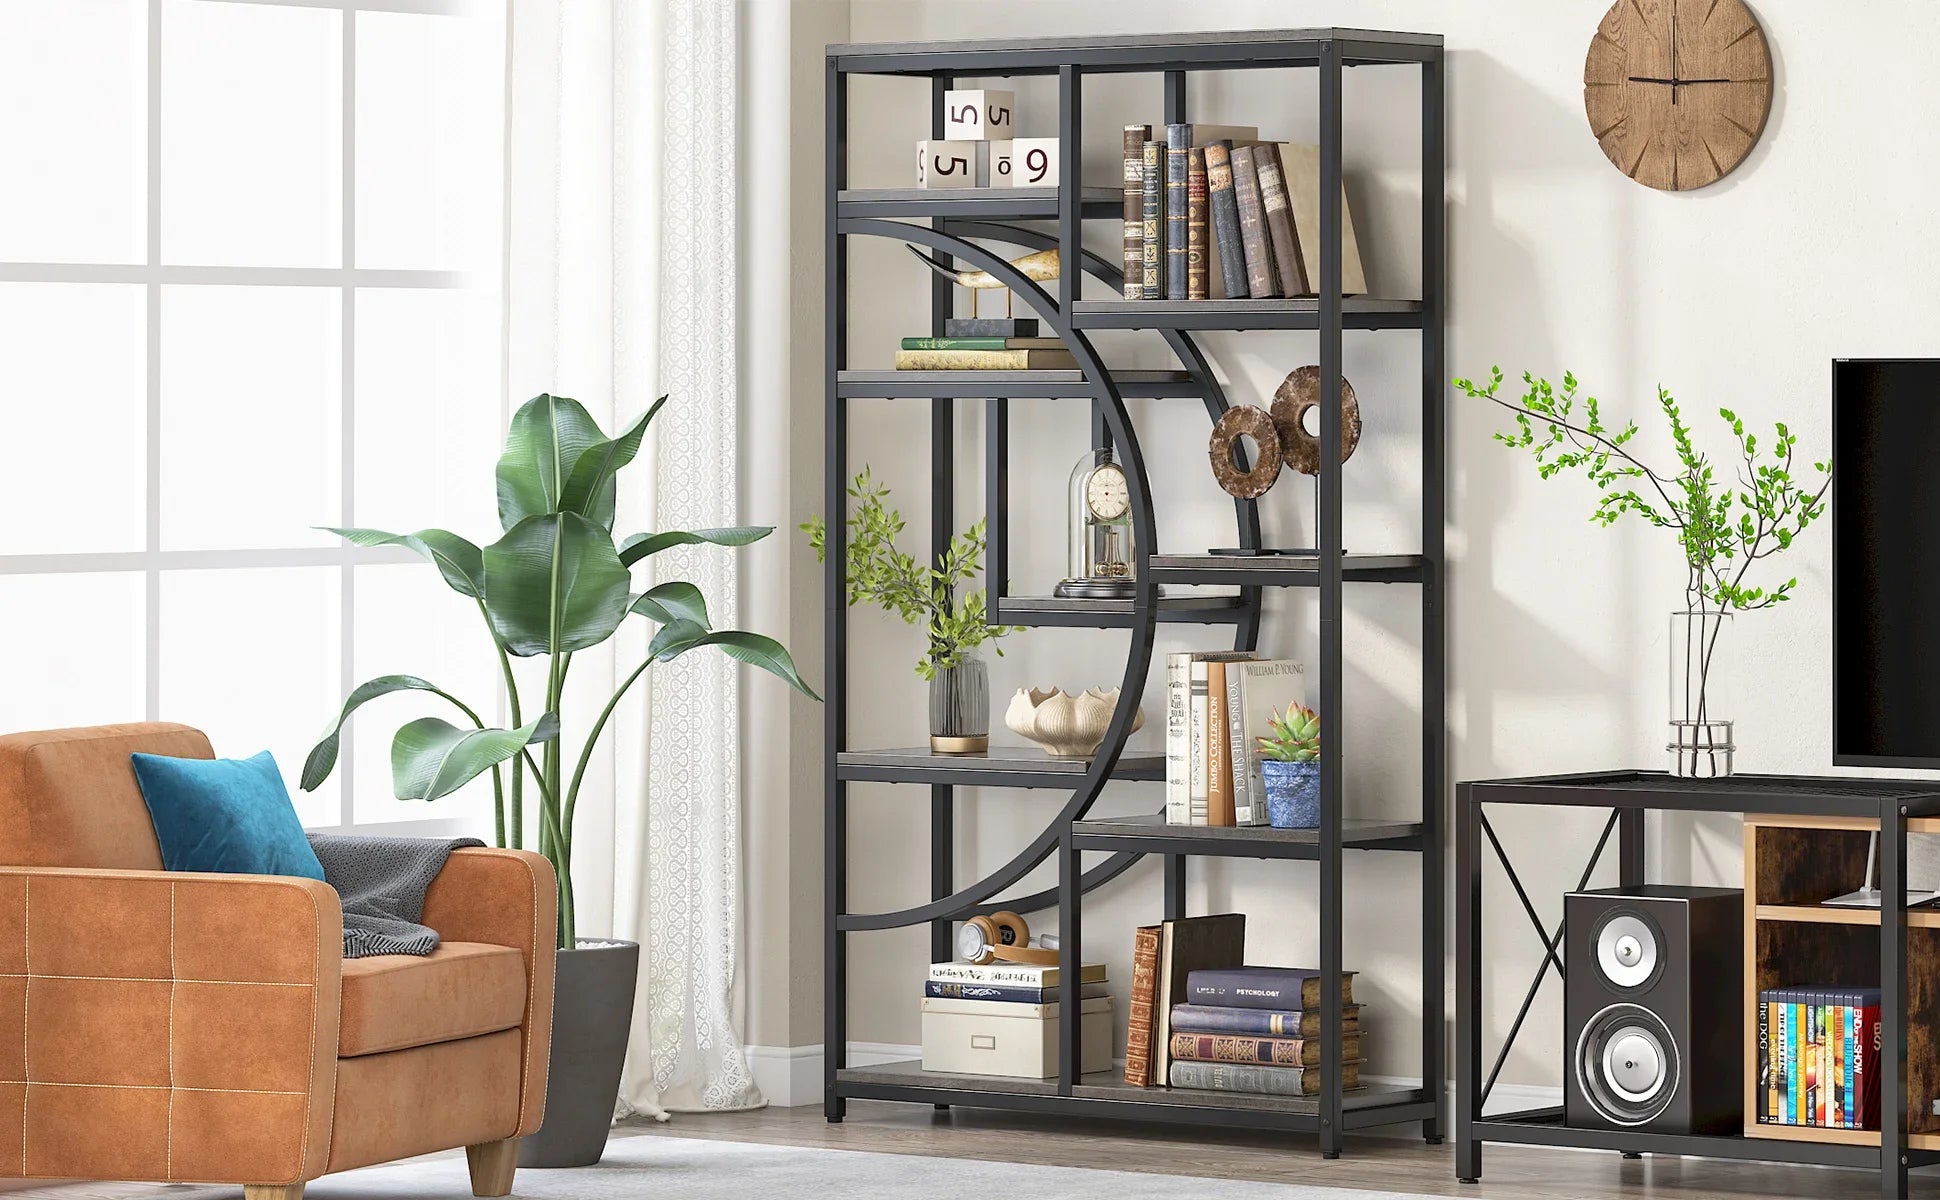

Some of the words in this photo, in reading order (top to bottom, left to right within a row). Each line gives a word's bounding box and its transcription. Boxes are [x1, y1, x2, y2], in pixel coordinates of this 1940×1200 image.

[1280, 663, 1304, 675] YOUNG
[1229, 681, 1241, 721] YOUNG
[1209, 696, 1218, 757] COLLECTION
[1231, 732, 1243, 754] THE
[1209, 759, 1220, 793] JUMBO
[1234, 757, 1246, 793] SHACK
[1236, 988, 1280, 998] PSYCHOLOGY
[1759, 1002, 1768, 1020] the
[1854, 1009, 1863, 1029] END
[1759, 1023, 1768, 1050] DOG
[1854, 1044, 1863, 1075] SHOW
